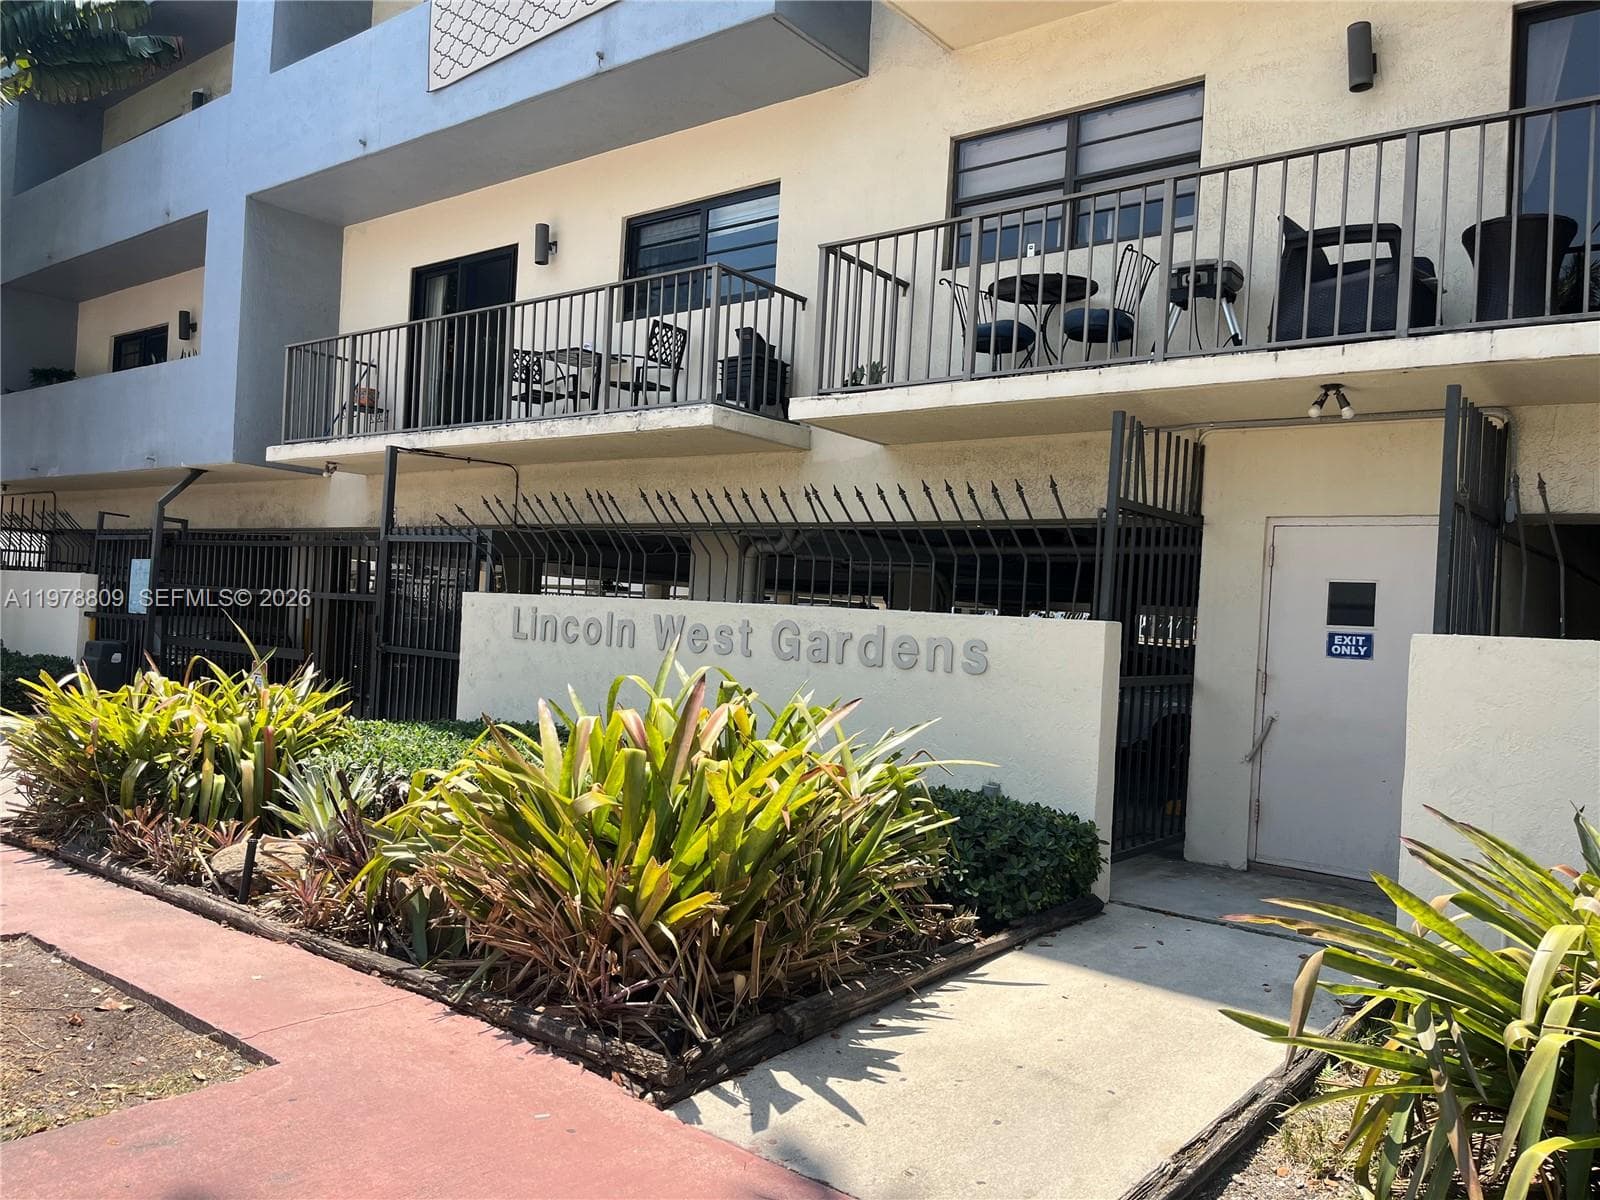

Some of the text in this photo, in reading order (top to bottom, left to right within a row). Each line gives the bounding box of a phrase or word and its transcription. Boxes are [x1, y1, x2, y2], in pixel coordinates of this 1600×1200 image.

[512, 606, 989, 676] Lincoln West Gardens
[1334, 635, 1366, 646] EXIT
[1331, 645, 1368, 656] ONLY
